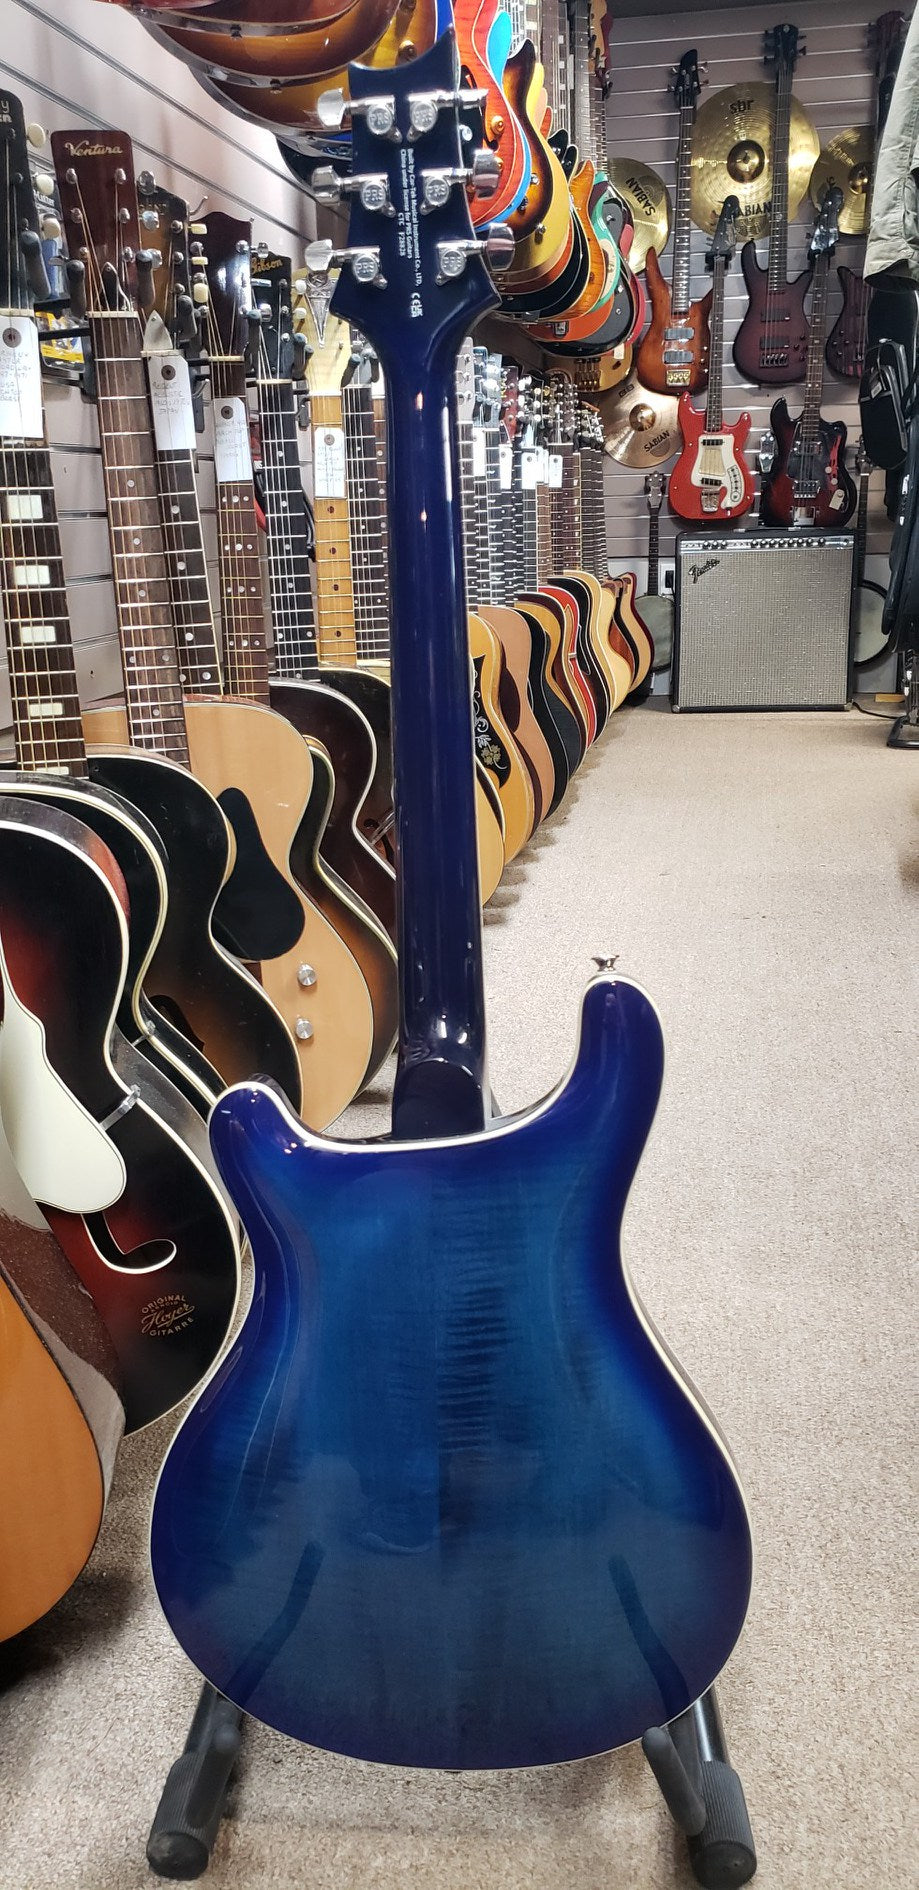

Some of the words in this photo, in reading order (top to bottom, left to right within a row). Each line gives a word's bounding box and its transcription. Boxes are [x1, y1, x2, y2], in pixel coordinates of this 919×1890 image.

[369, 112, 389, 124] PRS
[65, 140, 123, 157] Ventura
[364, 189, 384, 201] PRS
[427, 184, 447, 197] PRS
[625, 177, 656, 216] SABIAN
[411, 199, 419, 223] Musical
[738, 201, 773, 217] ABIAN
[412, 224, 420, 259] Instrument
[250, 257, 283, 276] Gibson
[355, 261, 375, 274] PRS
[643, 430, 670, 453] SABIAN
[141, 1294, 186, 1314] ORIGINAL
[149, 1317, 194, 1336] GITARRE
